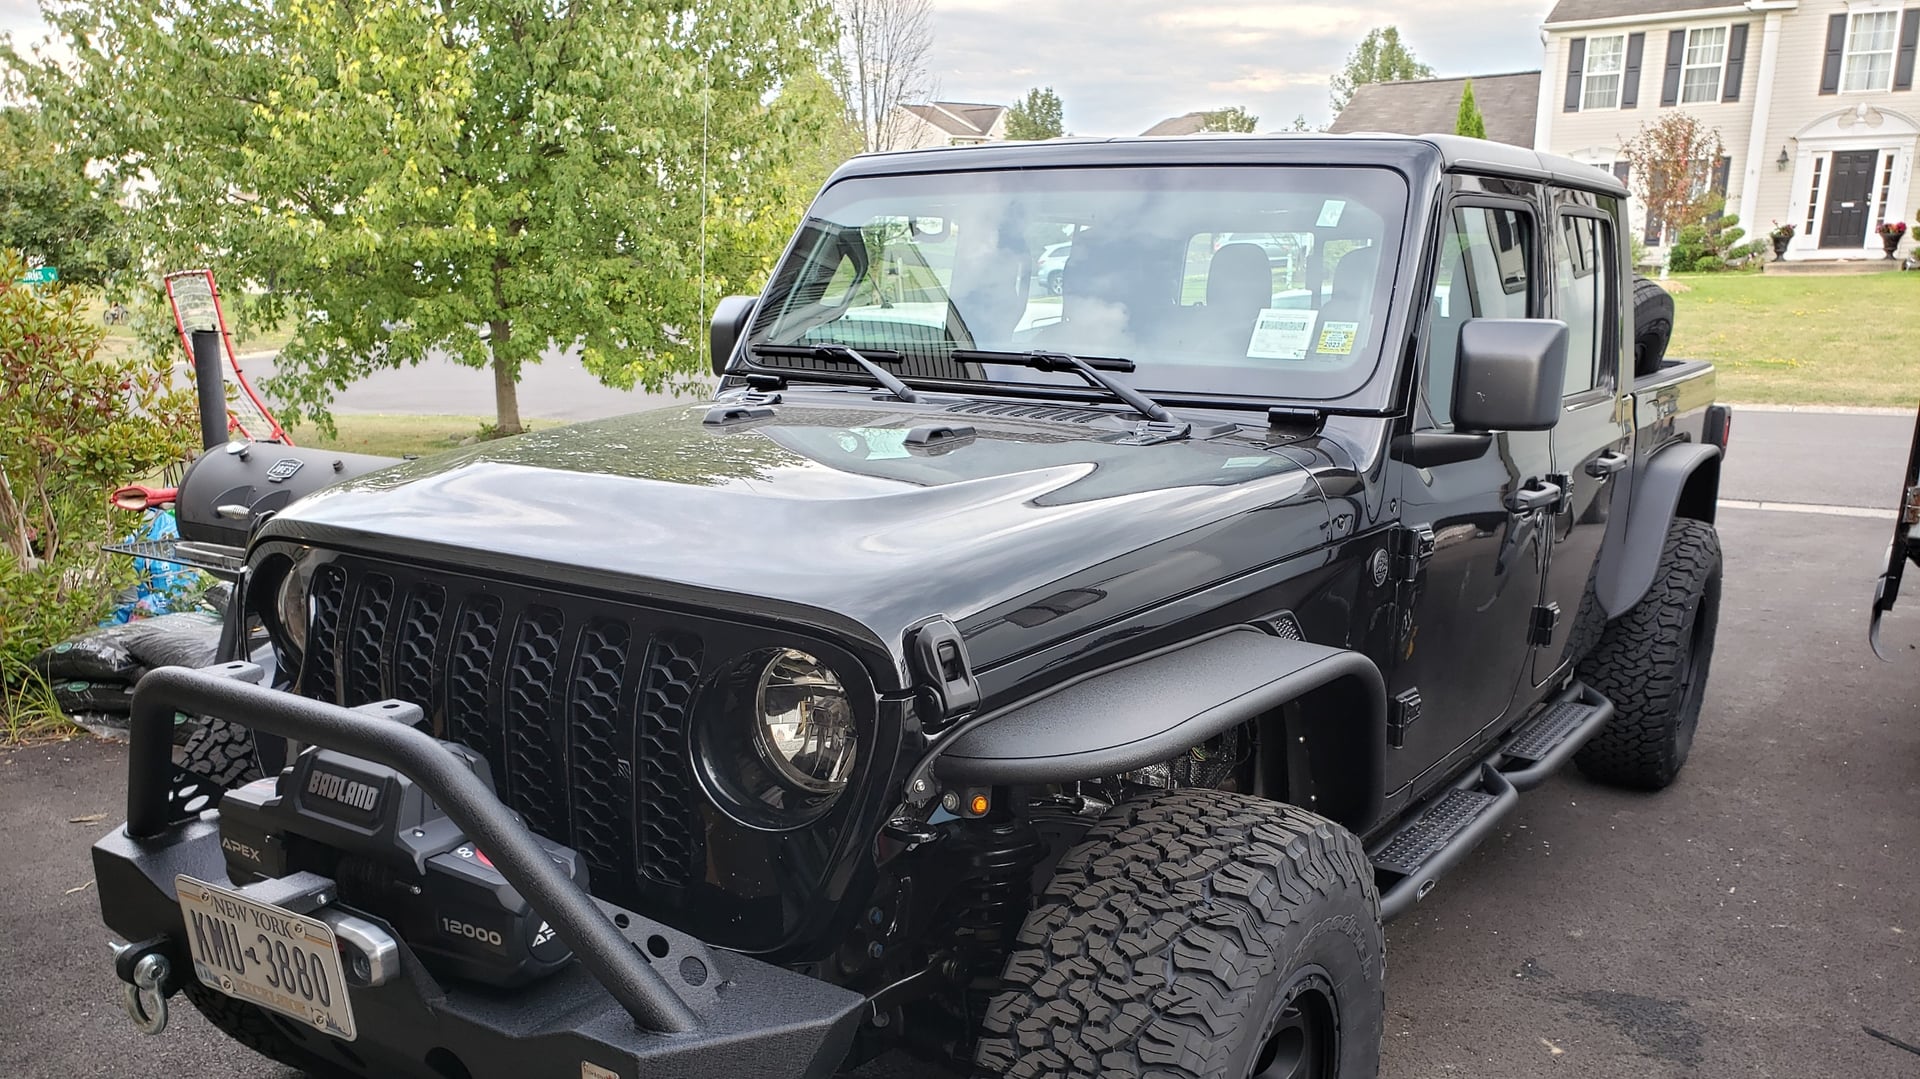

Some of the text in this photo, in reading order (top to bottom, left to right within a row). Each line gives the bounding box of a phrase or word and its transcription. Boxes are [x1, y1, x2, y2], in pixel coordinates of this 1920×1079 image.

[308, 769, 379, 811] BADLAND
[222, 837, 261, 862] APEX
[213, 896, 294, 940] NEW YORK
[442, 917, 502, 946] 12000
[190, 909, 246, 975] KMU
[257, 932, 331, 1008] 3880
